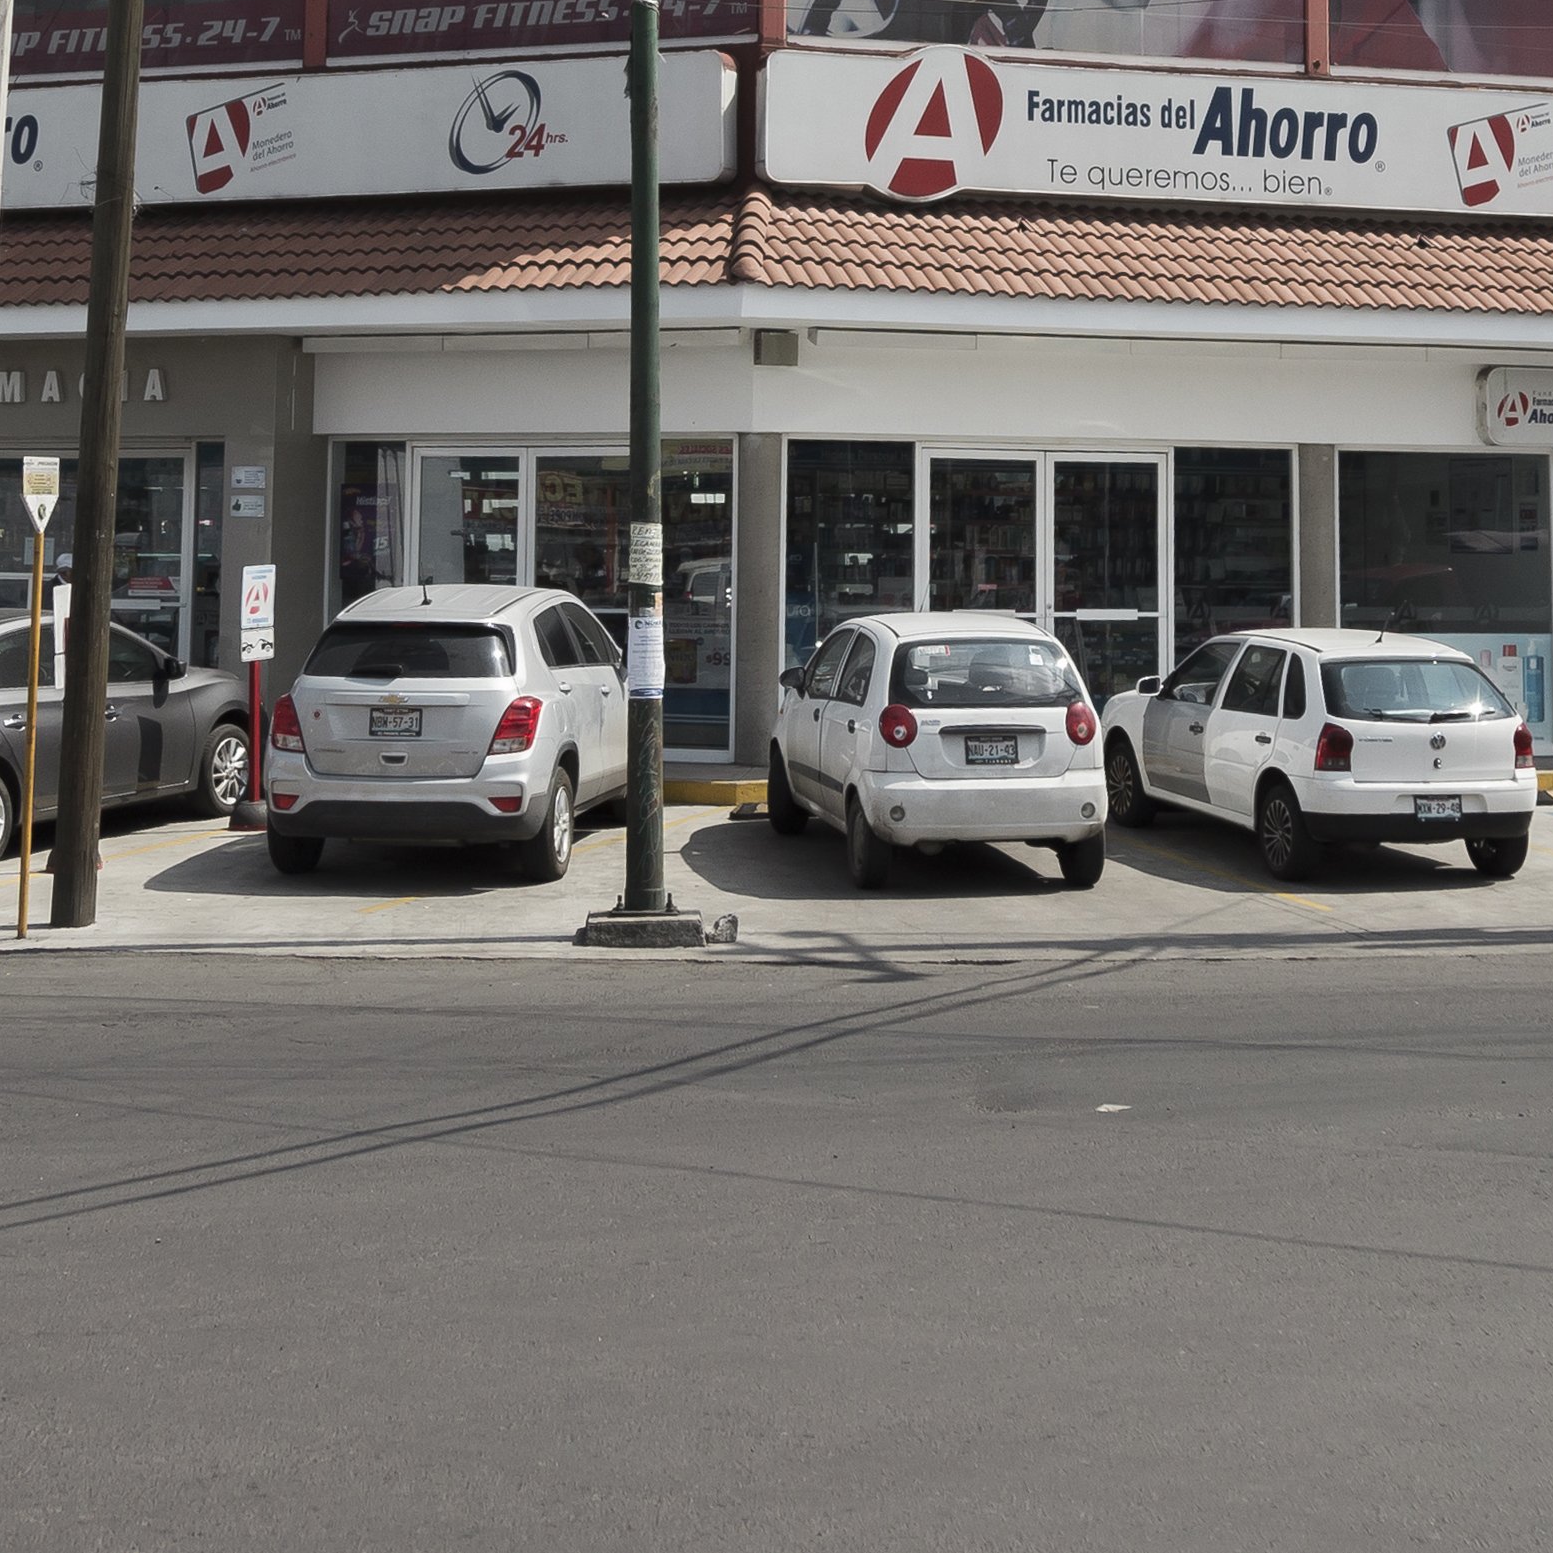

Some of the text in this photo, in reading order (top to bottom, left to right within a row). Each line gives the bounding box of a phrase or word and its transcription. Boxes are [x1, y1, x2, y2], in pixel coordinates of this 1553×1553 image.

[1027, 86, 1379, 165] Farmacias del Ahorro
[251, 130, 293, 151] Monedero
[252, 140, 295, 162] del Ahorro
[505, 124, 548, 158] 24
[1047, 158, 1079, 185] Te
[1519, 166, 1532, 178] del
